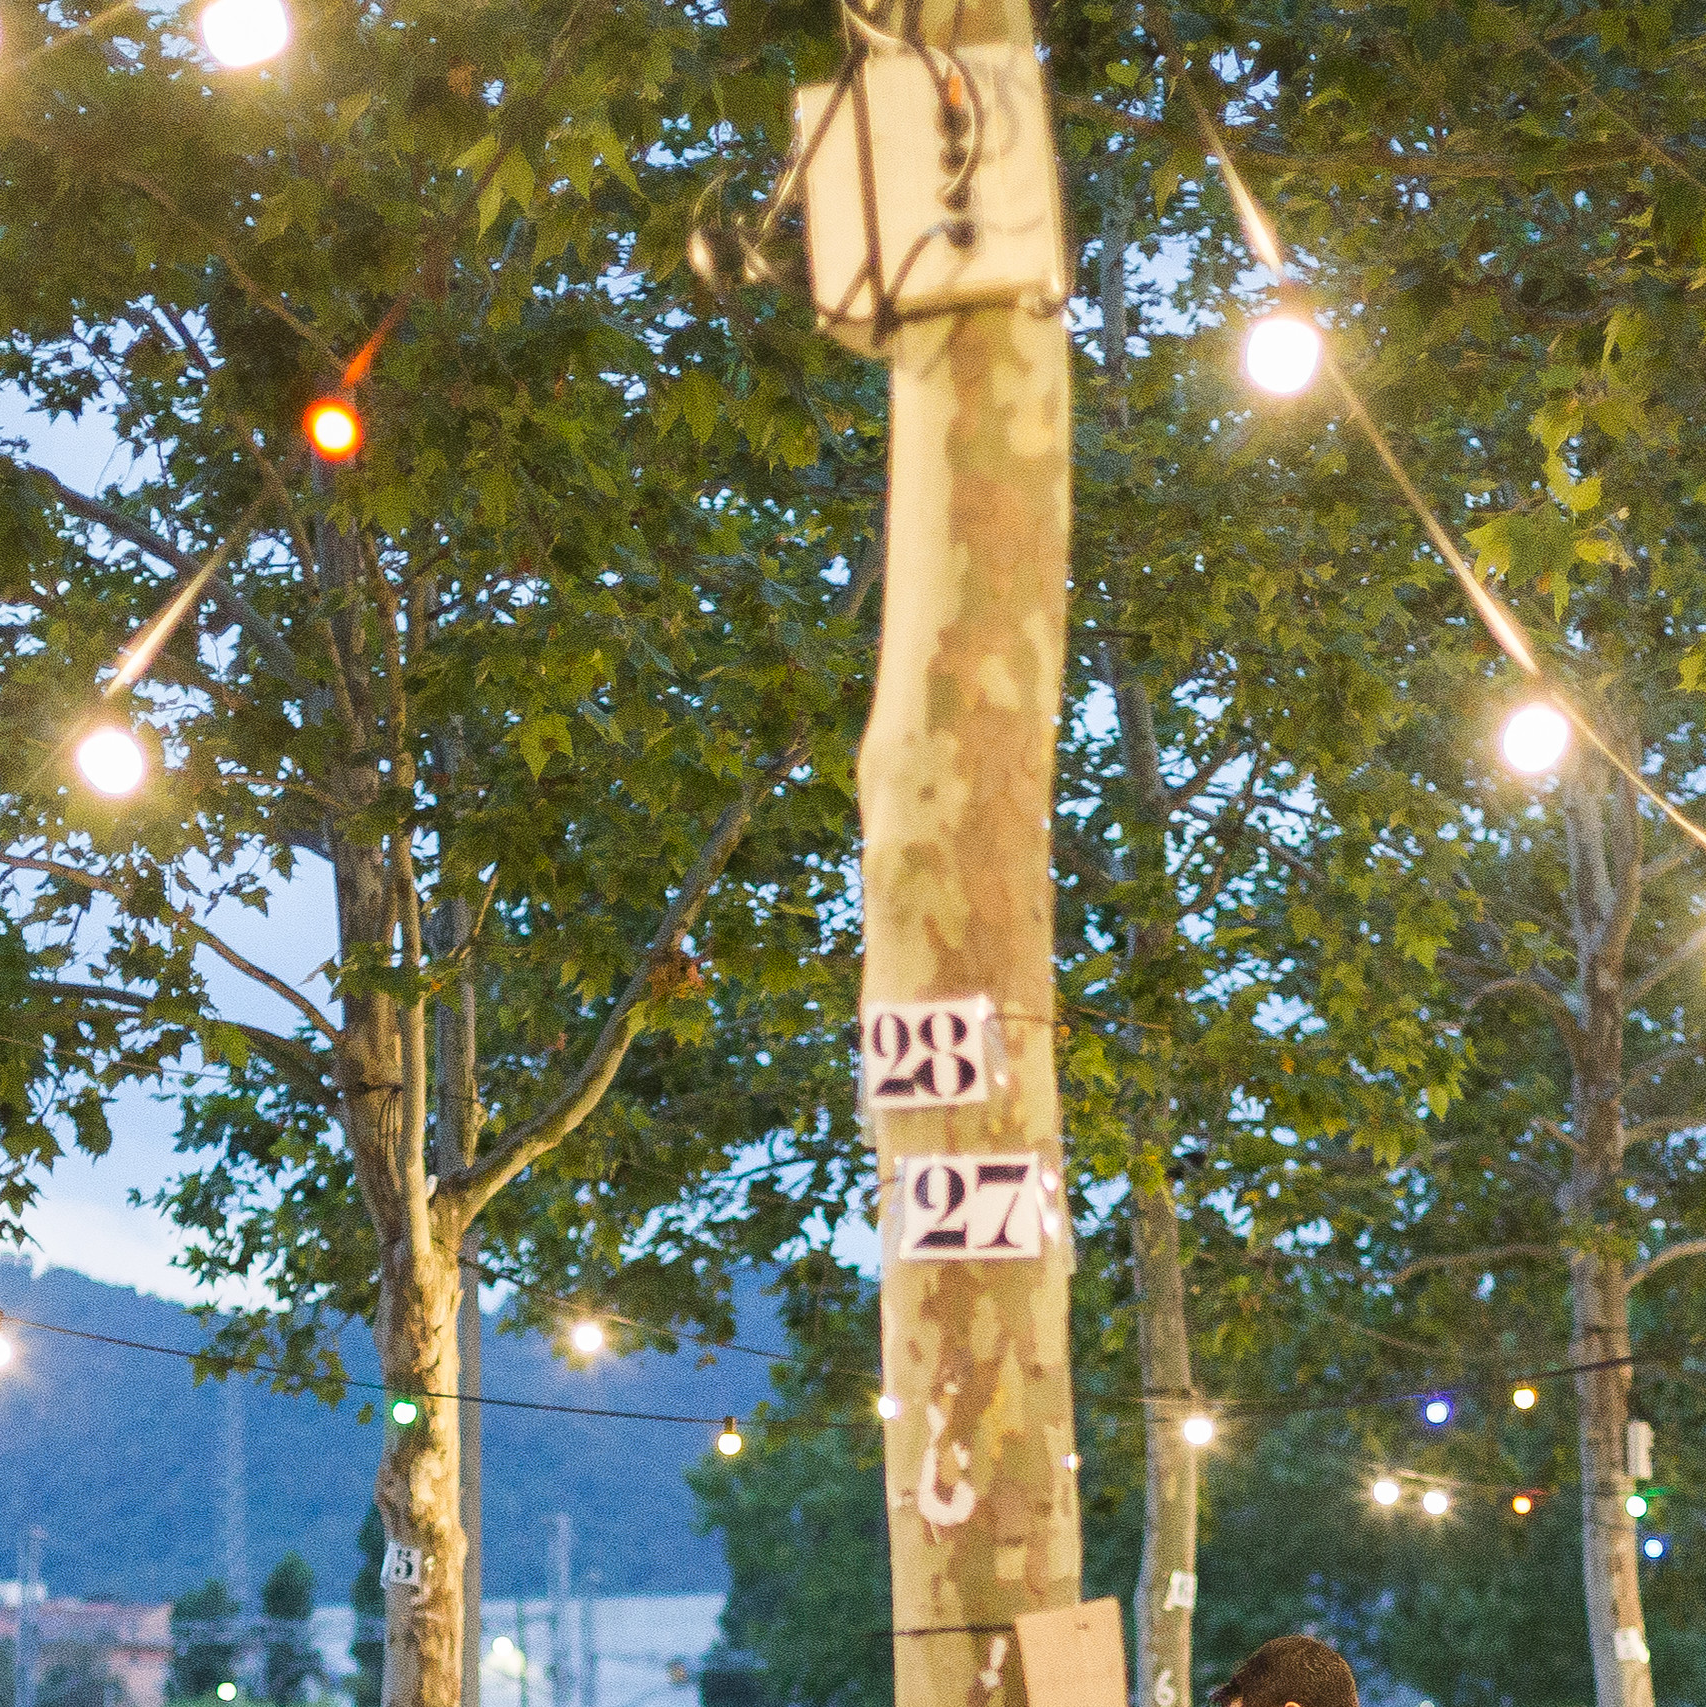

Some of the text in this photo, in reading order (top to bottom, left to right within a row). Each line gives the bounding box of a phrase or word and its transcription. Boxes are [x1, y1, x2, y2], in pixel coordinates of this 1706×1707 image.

[872, 1012, 976, 1097] 28
[914, 1165, 1029, 1249] 27
[395, 1548, 413, 1579] 5
